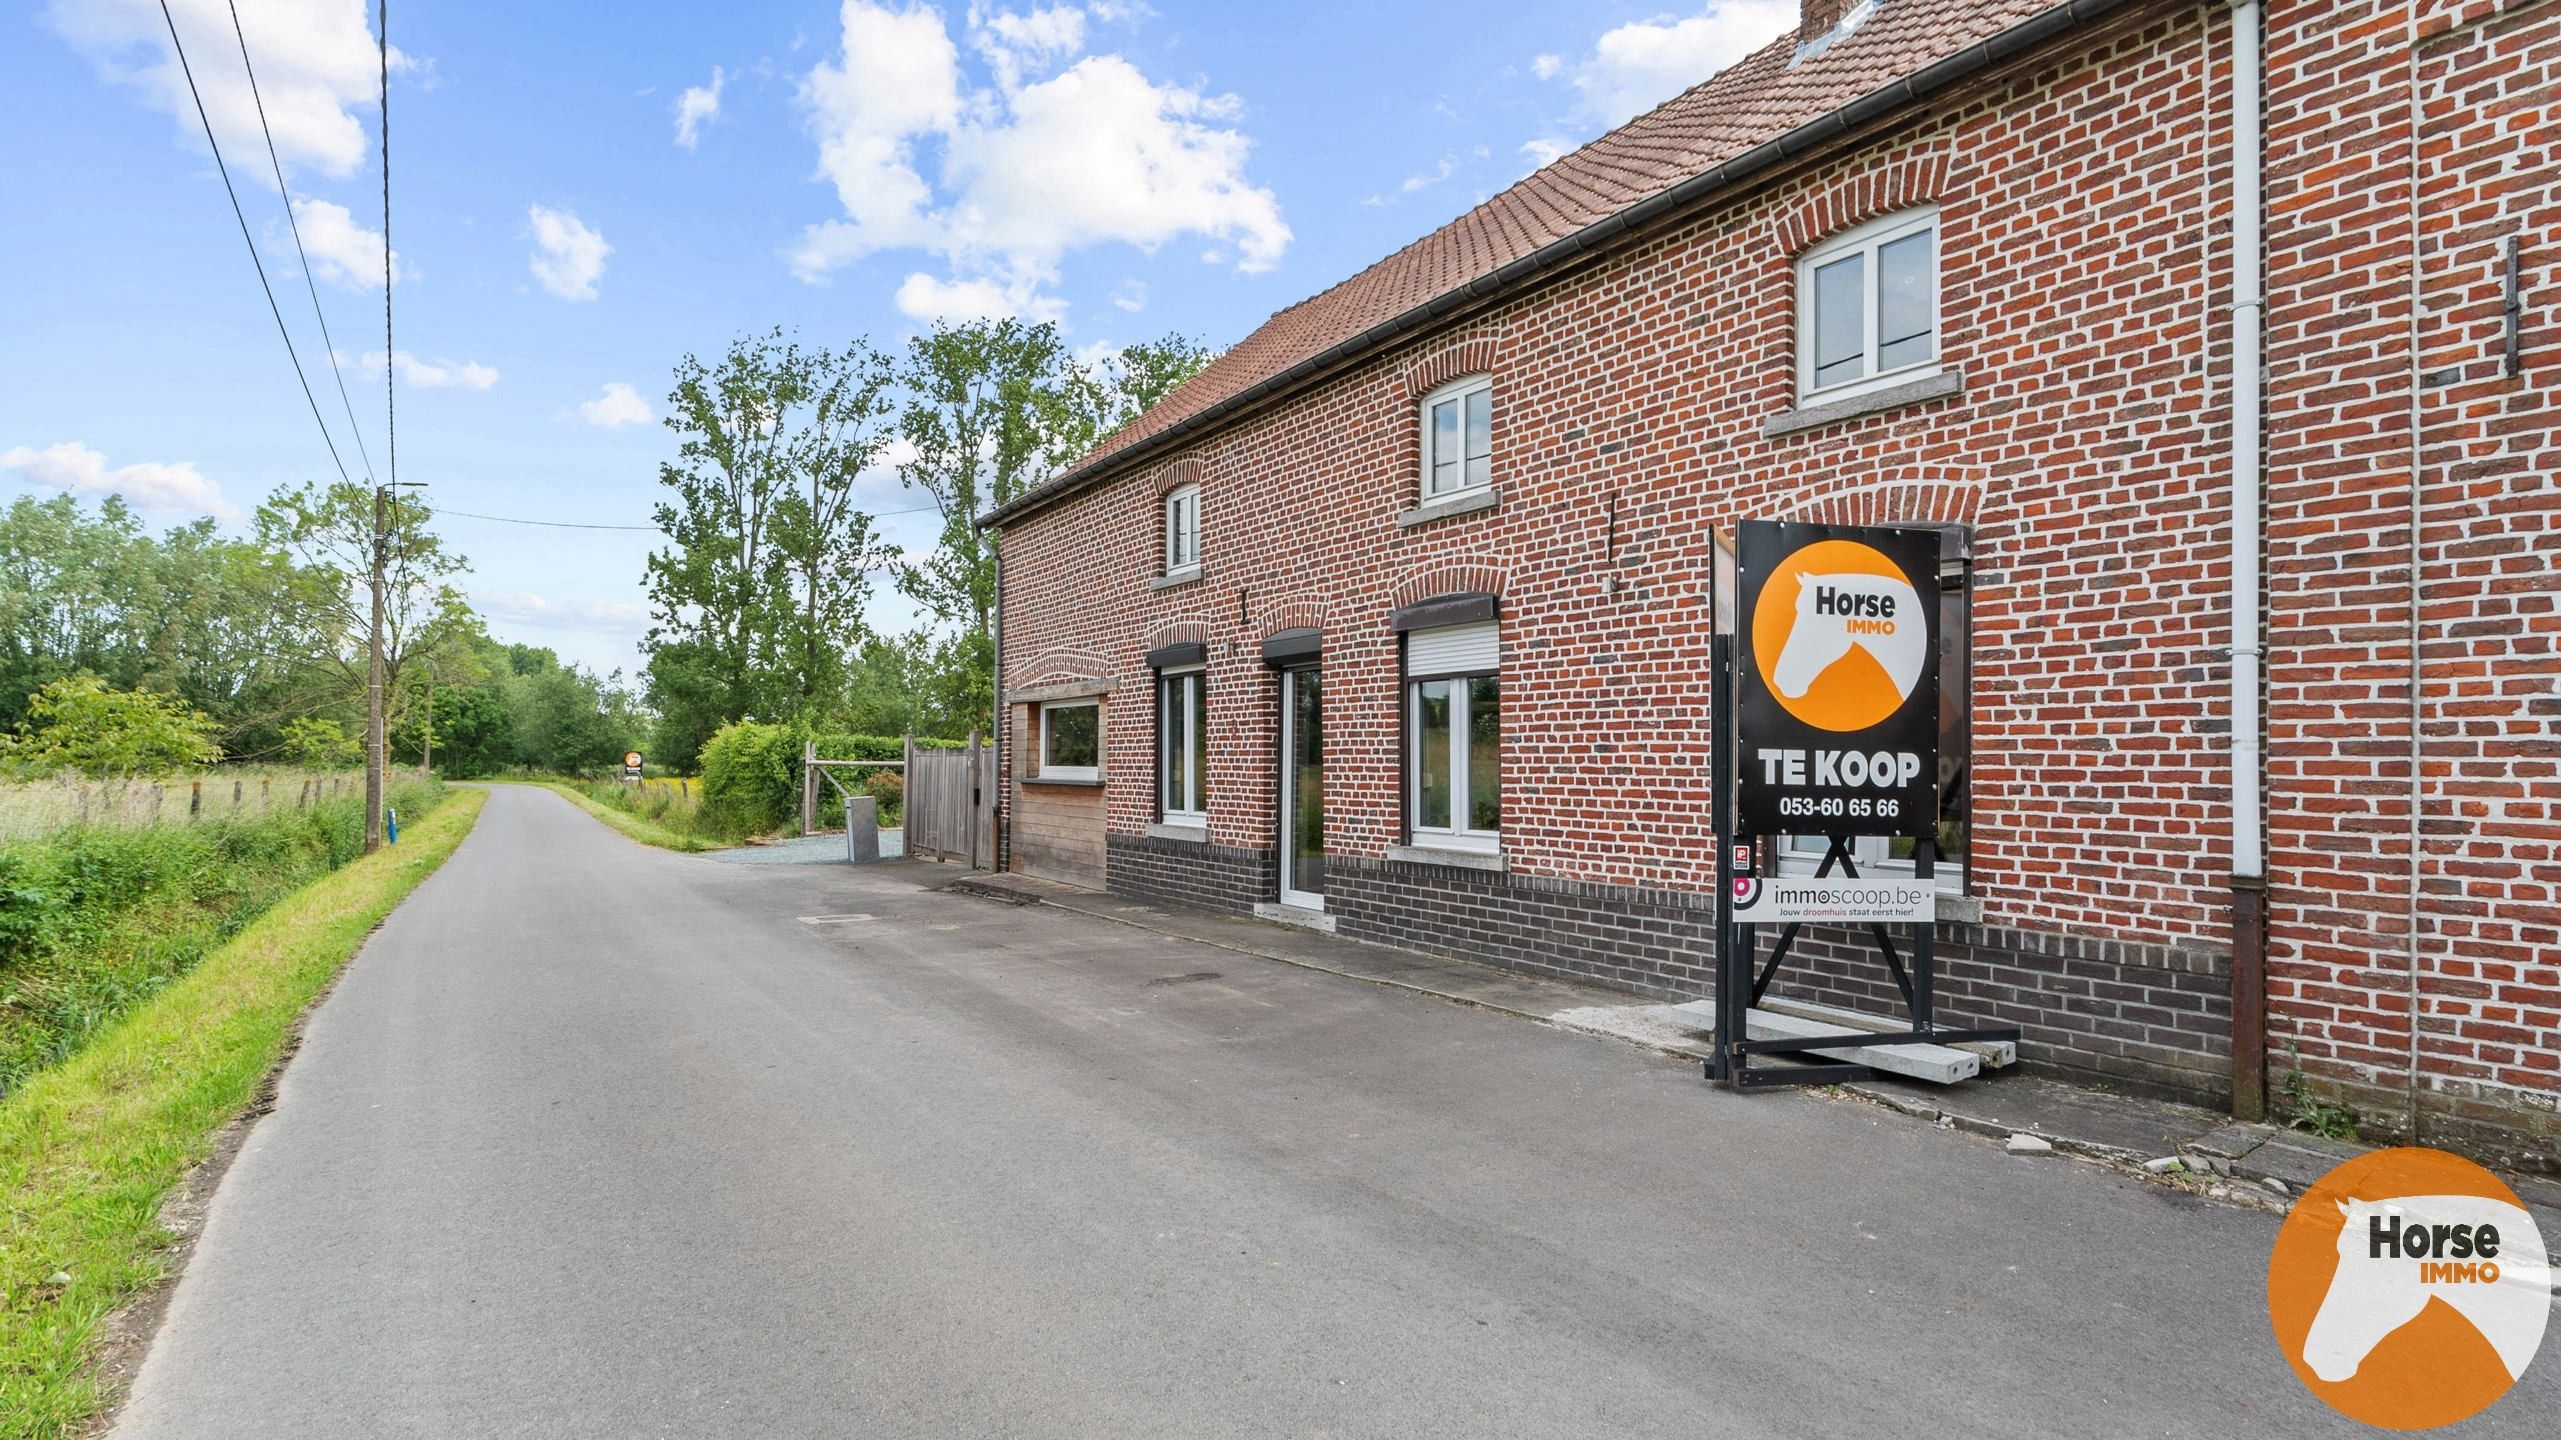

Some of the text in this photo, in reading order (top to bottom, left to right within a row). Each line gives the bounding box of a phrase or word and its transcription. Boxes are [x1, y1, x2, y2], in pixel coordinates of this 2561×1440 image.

[1815, 586, 1896, 618] Horse
[1846, 619, 1896, 636] IMMO
[1758, 748, 1806, 786] TE
[1815, 750, 1921, 788] KOOP
[1780, 797, 1900, 818] 053-60 65 66
[1775, 885, 1922, 909] immoscoop.be
[1779, 908, 1801, 916] Jouw
[1803, 908, 1847, 916] droomhuis
[1849, 908, 1870, 916] staat
[1872, 908, 1894, 916] eerst
